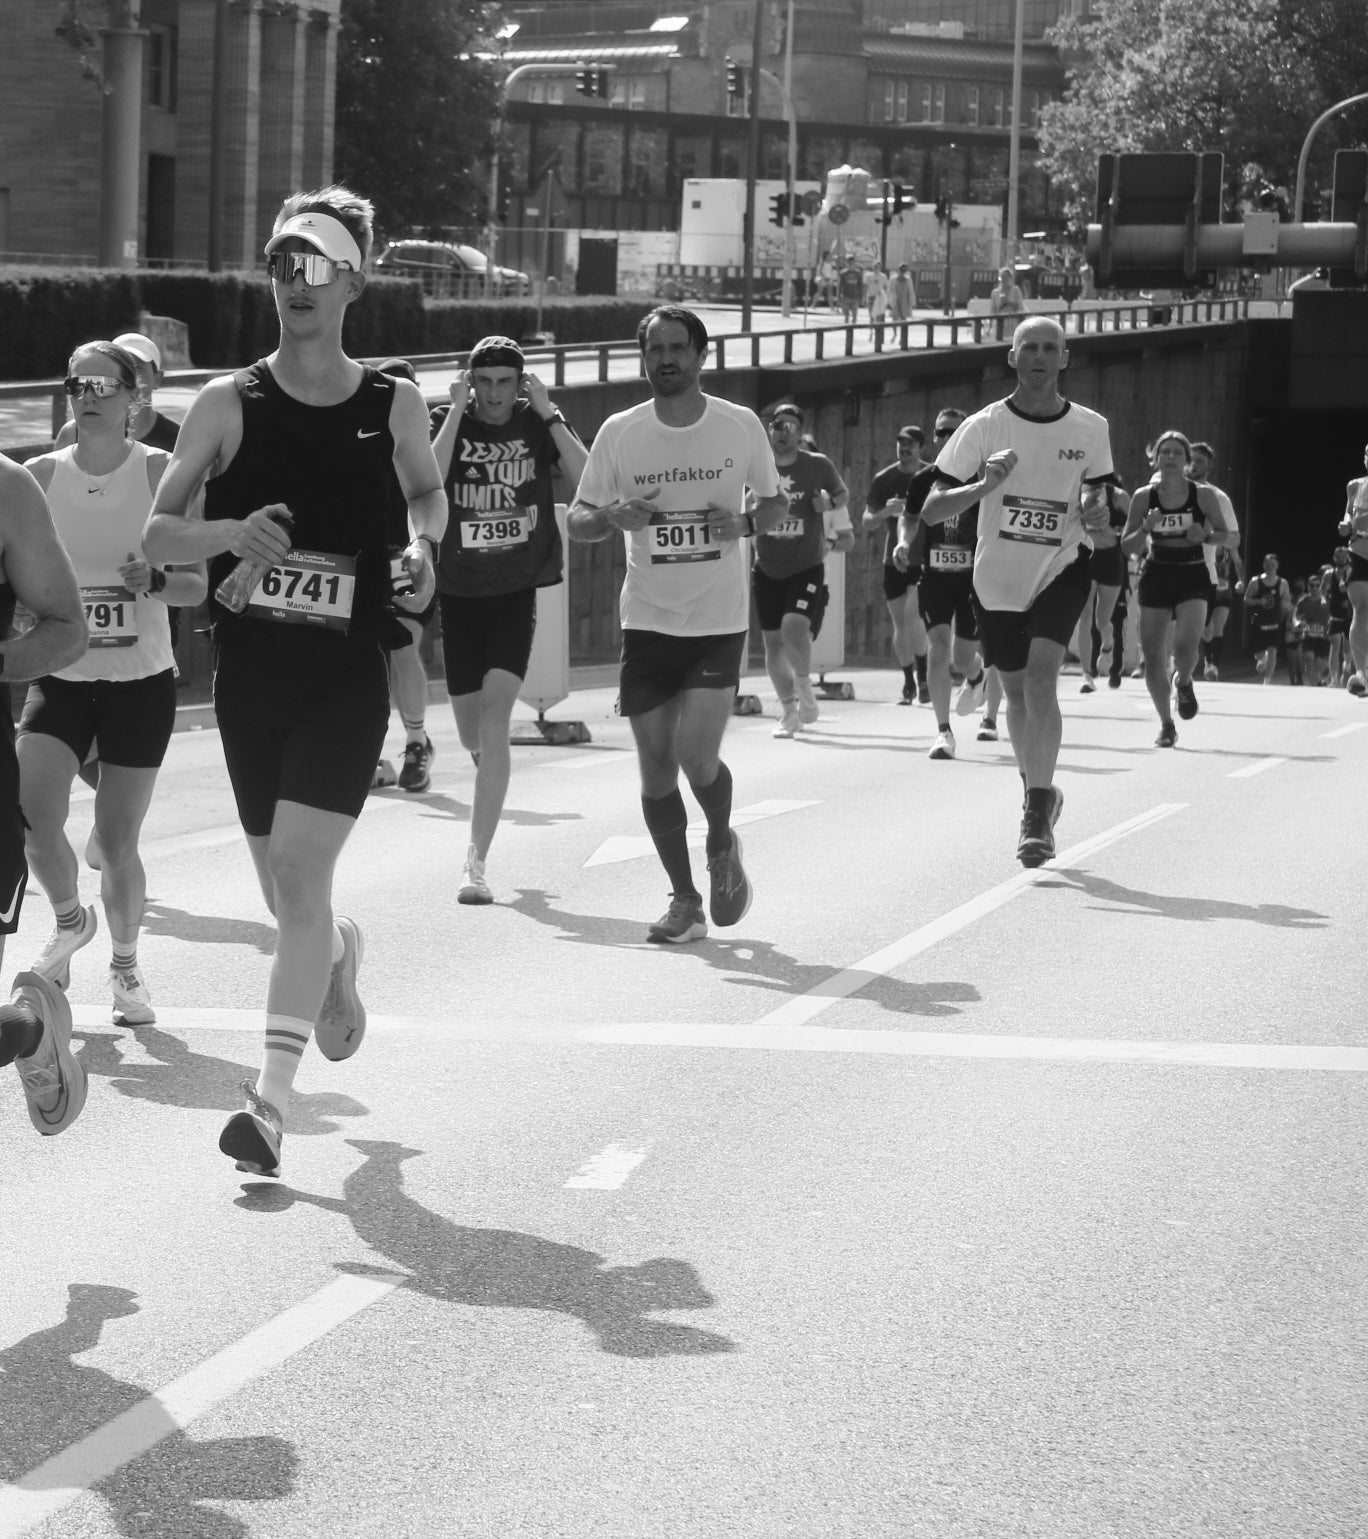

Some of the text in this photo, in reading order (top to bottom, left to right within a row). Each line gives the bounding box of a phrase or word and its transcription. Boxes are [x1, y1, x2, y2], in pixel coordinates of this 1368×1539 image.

[460, 438, 530, 463] LEAVE
[1058, 448, 1085, 460] NXP
[484, 457, 536, 488] YOUR
[634, 467, 723, 485] wertfaktor
[453, 482, 516, 511] LIMITS
[468, 520, 522, 541] 7398
[1008, 508, 1059, 532] 7335
[656, 524, 710, 547] 5011
[285, 551, 304, 563] ella
[935, 551, 967, 564] 1553
[262, 567, 340, 605] 6741
[286, 600, 314, 611] Marvin
